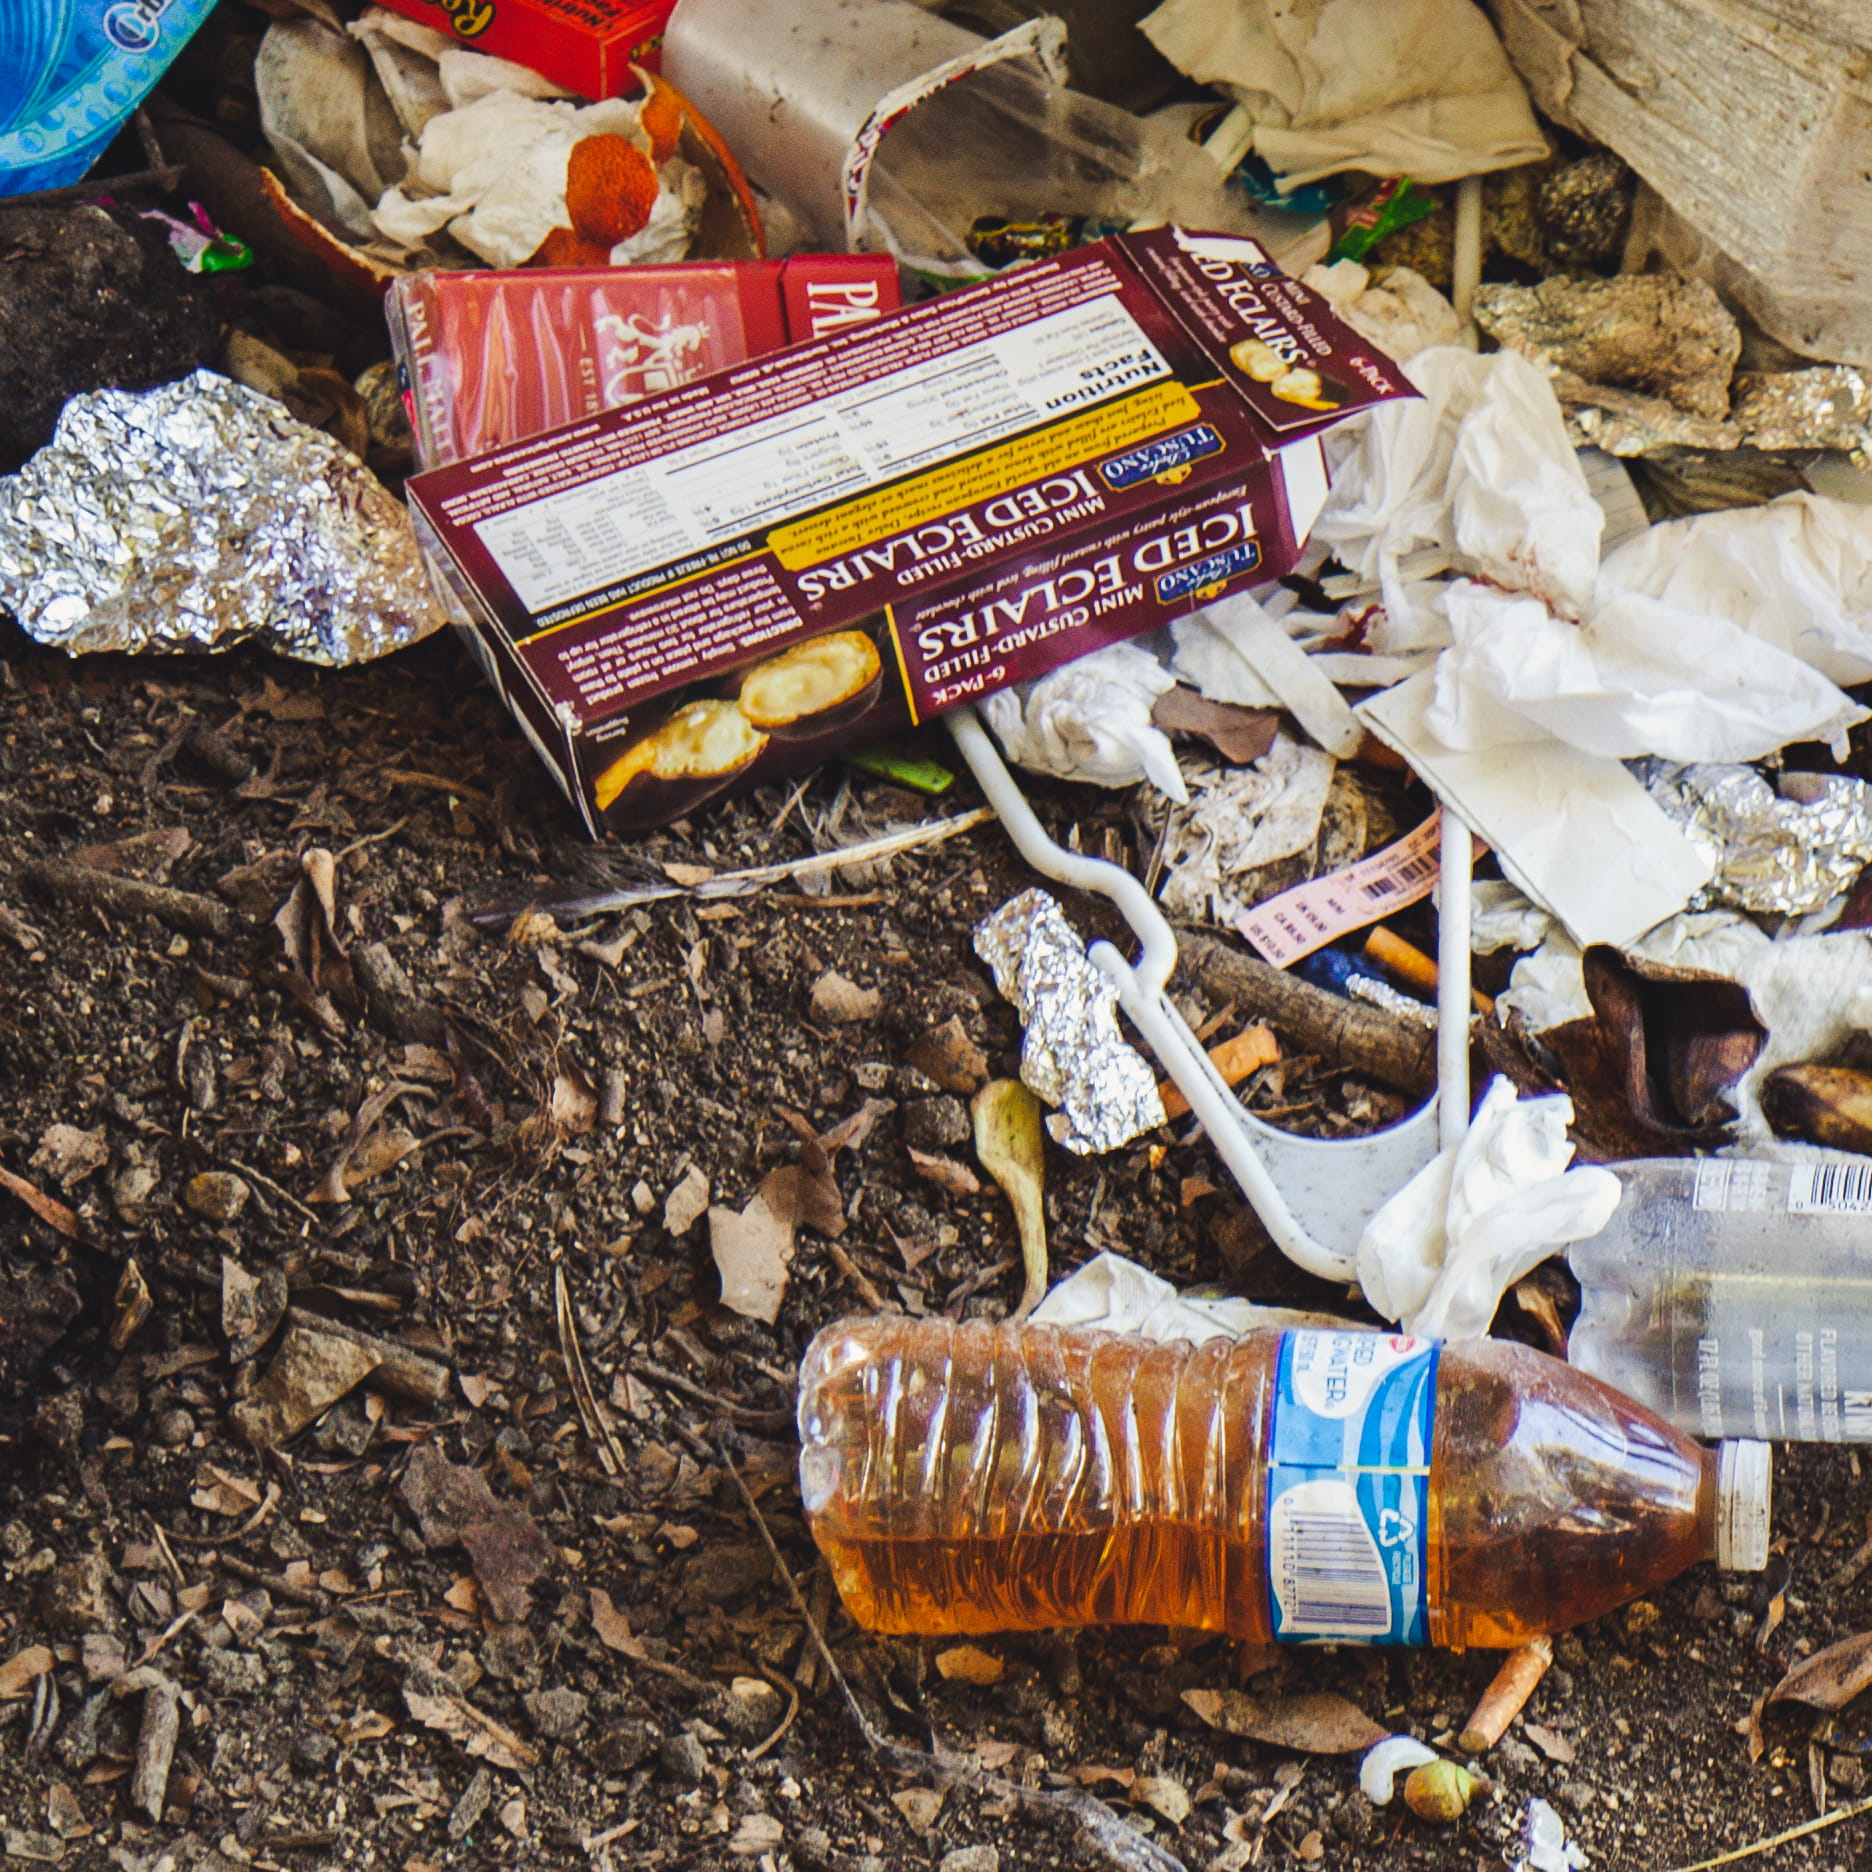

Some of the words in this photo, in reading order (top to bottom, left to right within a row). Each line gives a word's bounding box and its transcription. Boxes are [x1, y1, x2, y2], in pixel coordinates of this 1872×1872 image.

[1215, 268, 1308, 376] ECLAIRS
[404, 300, 435, 373] PALL
[579, 357, 593, 386] EST
[1078, 346, 1151, 384] Facts
[1044, 359, 1161, 413] Nutrition
[1104, 402, 1129, 420] Just
[1161, 395, 1185, 411] Iced
[1073, 414, 1105, 433] thaw
[1098, 422, 1116, 434] are
[1111, 414, 1167, 444] Prepared
[1118, 406, 1160, 428] Eclairs
[1015, 436, 1045, 453] serve
[1047, 426, 1072, 443] and
[1064, 427, 1098, 449] filled
[1080, 436, 1111, 456] from
[995, 446, 1015, 462] for
[1002, 453, 1035, 473] dense
[1036, 442, 1064, 460] with
[1063, 449, 1080, 461] an
[1102, 424, 1215, 480] TUSCANO
[930, 459, 985, 487] delicious
[1004, 465, 1041, 485] world
[1041, 456, 1062, 471] old
[896, 480, 930, 500] snack
[957, 466, 1001, 490] custard
[932, 484, 956, 500] and
[944, 479, 1001, 508] European
[981, 466, 1099, 534] ICED
[833, 497, 878, 523] elegant
[880, 493, 931, 519] crowned
[1053, 494, 1105, 527] MINI
[850, 512, 879, 530] with
[865, 517, 901, 538] Dolce
[779, 537, 813, 555] cocoa
[814, 527, 839, 544] rich
[814, 532, 863, 558] Tuscano
[1101, 528, 1132, 549] with
[1127, 501, 1262, 578] ICED
[794, 509, 986, 605] ECLAIRS
[894, 514, 1056, 589] CUSTARD-FILLED
[1156, 541, 1256, 592] TUSCANO
[966, 582, 995, 602] with
[1091, 582, 1146, 616] MINI
[911, 552, 1131, 662] ECLAIRS
[919, 604, 1092, 685] CUSTARD-FILLED
[929, 663, 1008, 706] 6-PACK
[1795, 1201, 1803, 1210] 0
[1281, 1526, 1296, 1570] 11110
[1281, 1578, 1298, 1614] 87721
